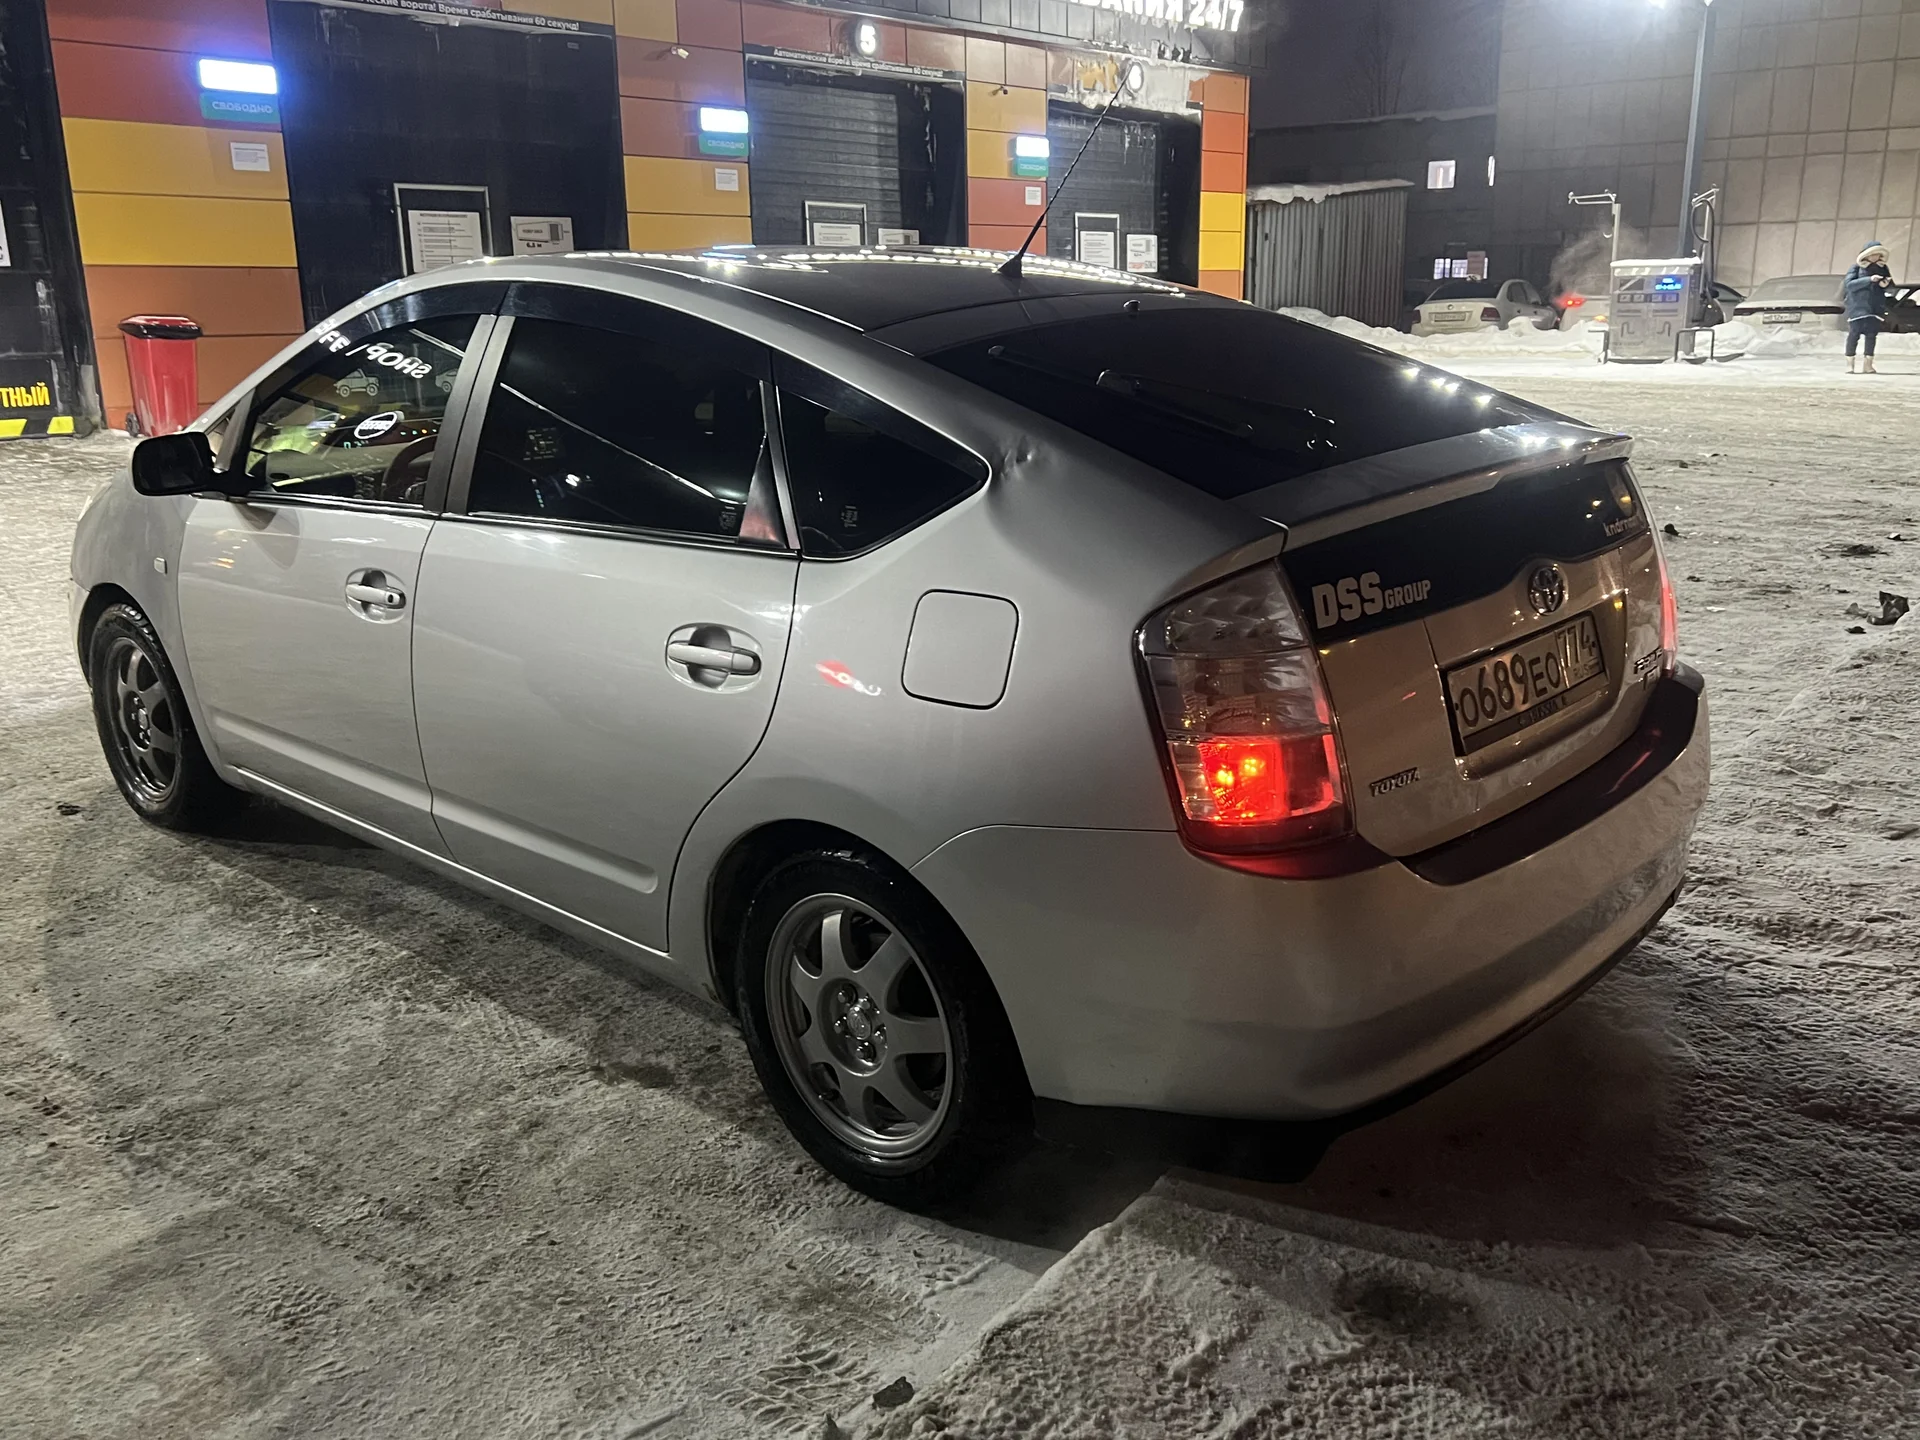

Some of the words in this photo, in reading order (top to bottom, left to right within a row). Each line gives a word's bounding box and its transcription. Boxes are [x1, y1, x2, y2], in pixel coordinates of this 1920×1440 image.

[438, 4, 470, 16] Время
[471, 9, 534, 25] срабатывания
[534, 16, 547, 26] 60
[547, 19, 580, 31] секунд!
[1188, 0, 1245, 32] 24/7
[861, 25, 876, 54] 5
[211, 100, 274, 114] СВОБОДНО
[1311, 571, 1384, 629] DSS
[1384, 579, 1431, 610] GROUP
[1368, 766, 1421, 798] TOYOTA
